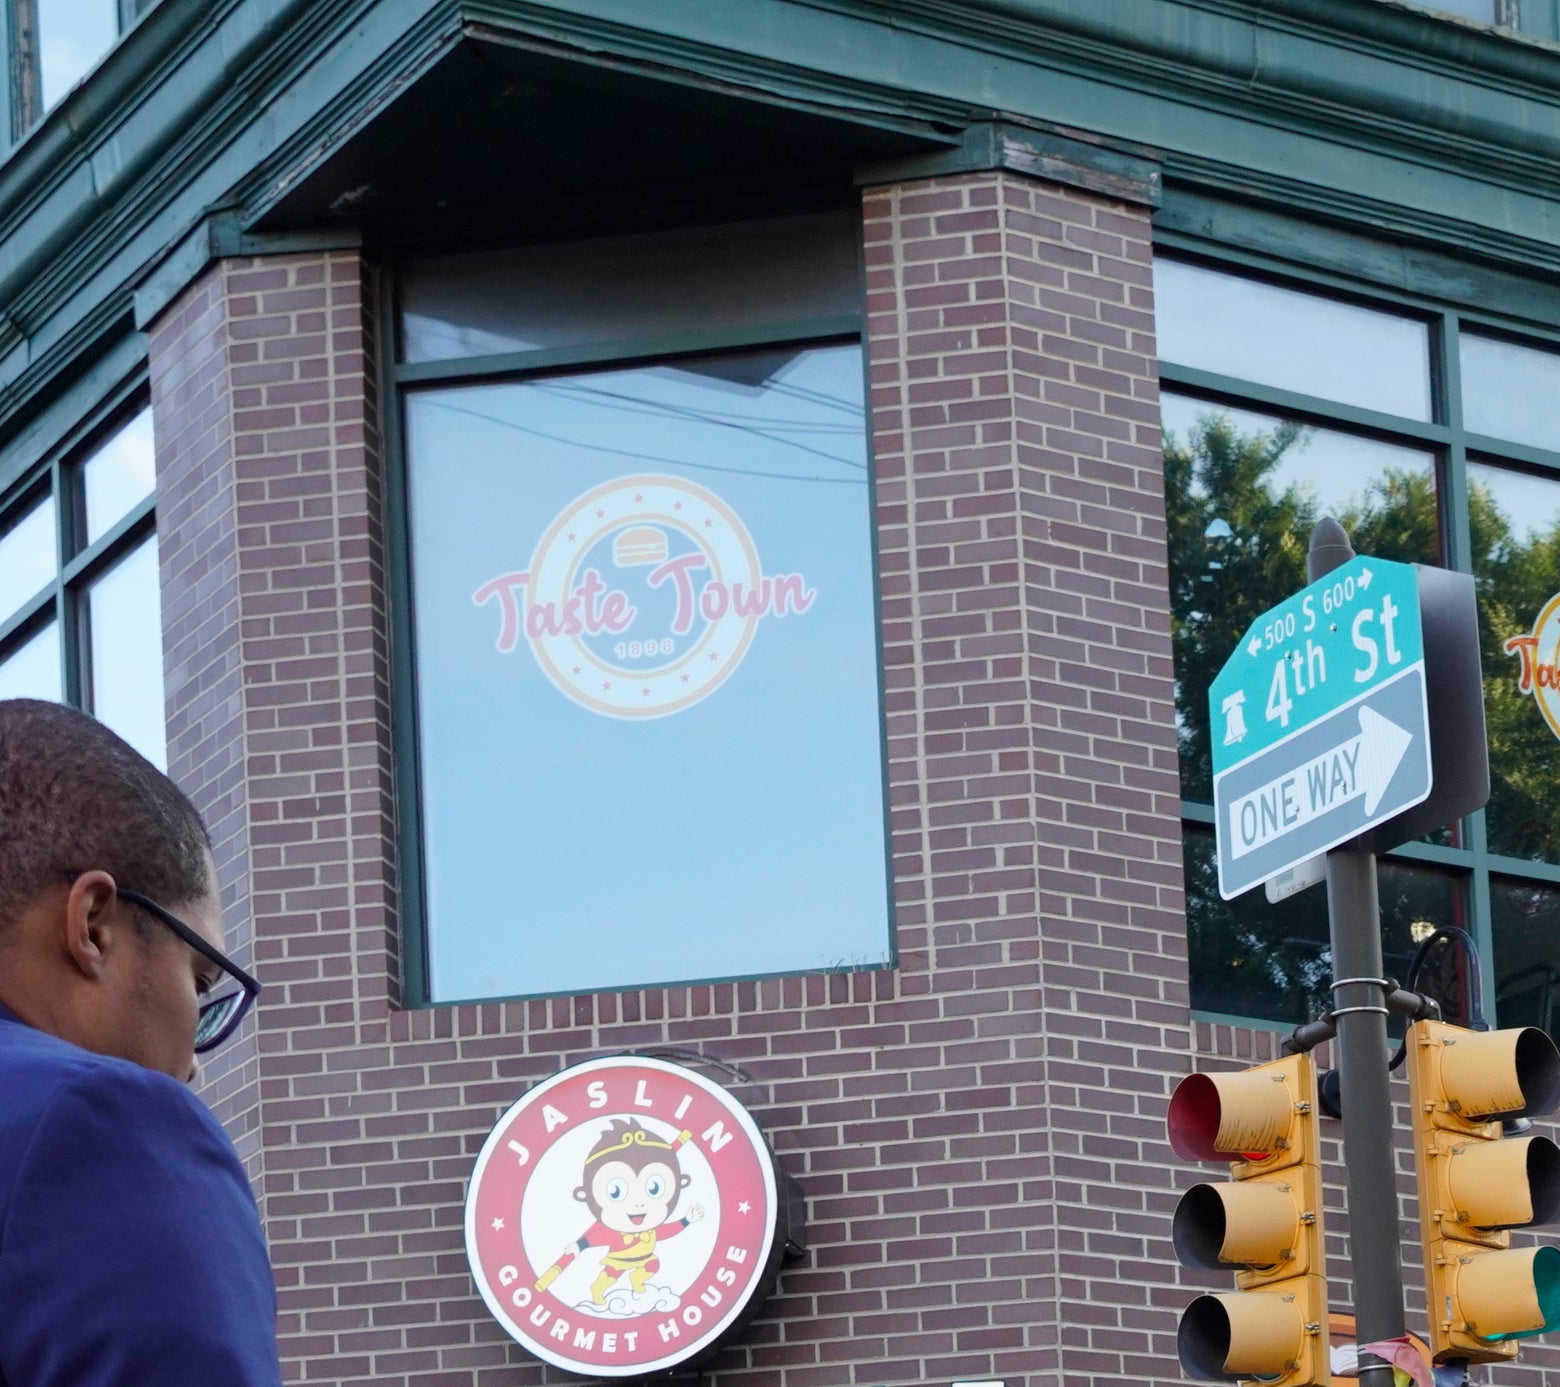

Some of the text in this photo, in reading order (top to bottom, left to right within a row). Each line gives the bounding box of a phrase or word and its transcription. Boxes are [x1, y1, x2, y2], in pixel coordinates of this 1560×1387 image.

[474, 553, 817, 653] Taste Town
[613, 637, 676, 659] 1898
[1264, 576, 1355, 650] 500 S 600
[1265, 593, 1402, 728] 4th St
[1241, 741, 1361, 846] ONE WAY
[508, 1079, 734, 1167] JASLIN
[497, 1242, 747, 1354] GOURMET HOUSE
